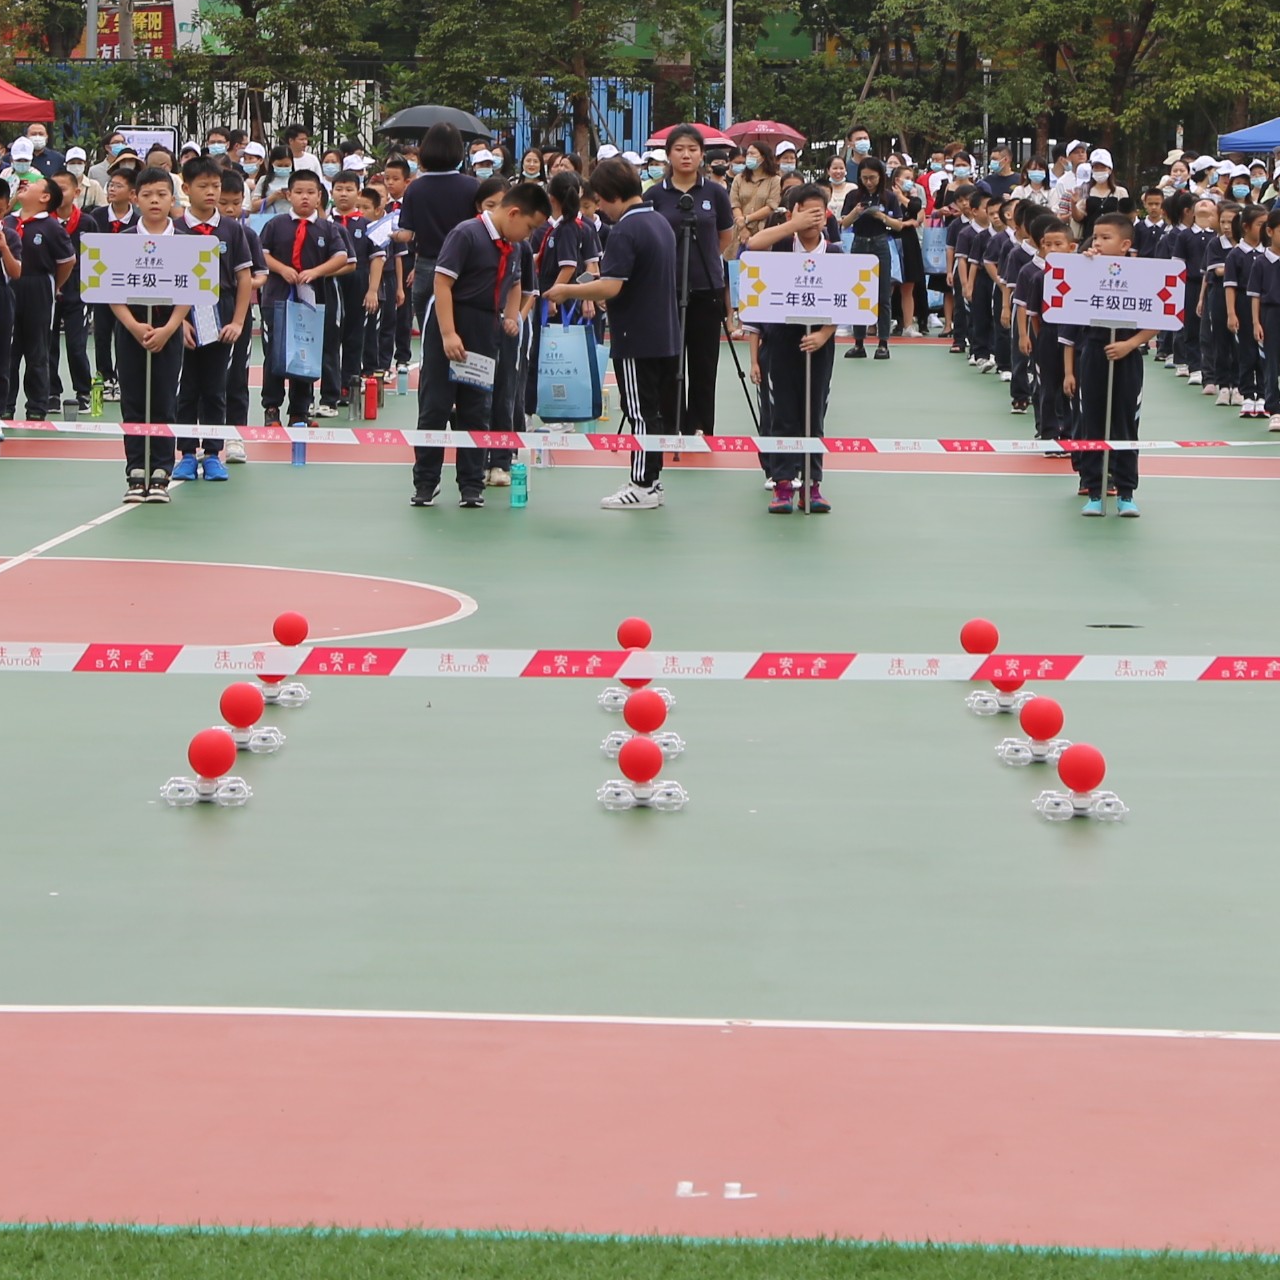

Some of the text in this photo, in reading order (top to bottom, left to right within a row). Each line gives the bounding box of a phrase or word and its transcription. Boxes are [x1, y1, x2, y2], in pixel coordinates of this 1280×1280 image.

[111, 273, 188, 288] 三年级一班
[770, 292, 847, 308] 二年级一班
[1074, 294, 1153, 312] 一年级四班
[106, 648, 154, 661] 安全
[216, 650, 266, 662] 注意
[330, 652, 377, 665] 安全
[440, 653, 489, 665] 注意
[554, 654, 602, 666] 安全
[95, 659, 147, 668] SAFE
[214, 660, 263, 670] CAUTION
[665, 655, 714, 667] 注意
[779, 656, 827, 669] 安全
[890, 657, 940, 669] 注意
[1005, 658, 1054, 670] 安全
[1117, 659, 1168, 670] 注意
[1233, 660, 1280, 671] 安全
[319, 662, 370, 672] SAFE
[438, 663, 487, 672] CAUTION
[543, 665, 594, 674] SAFE
[662, 665, 712, 674] CAUTION
[768, 667, 819, 676] SAFE
[888, 668, 938, 676] CAUTION
[994, 668, 1045, 677] SAFE
[1115, 668, 1164, 677] CAUTION
[1221, 670, 1273, 678] SAFE
